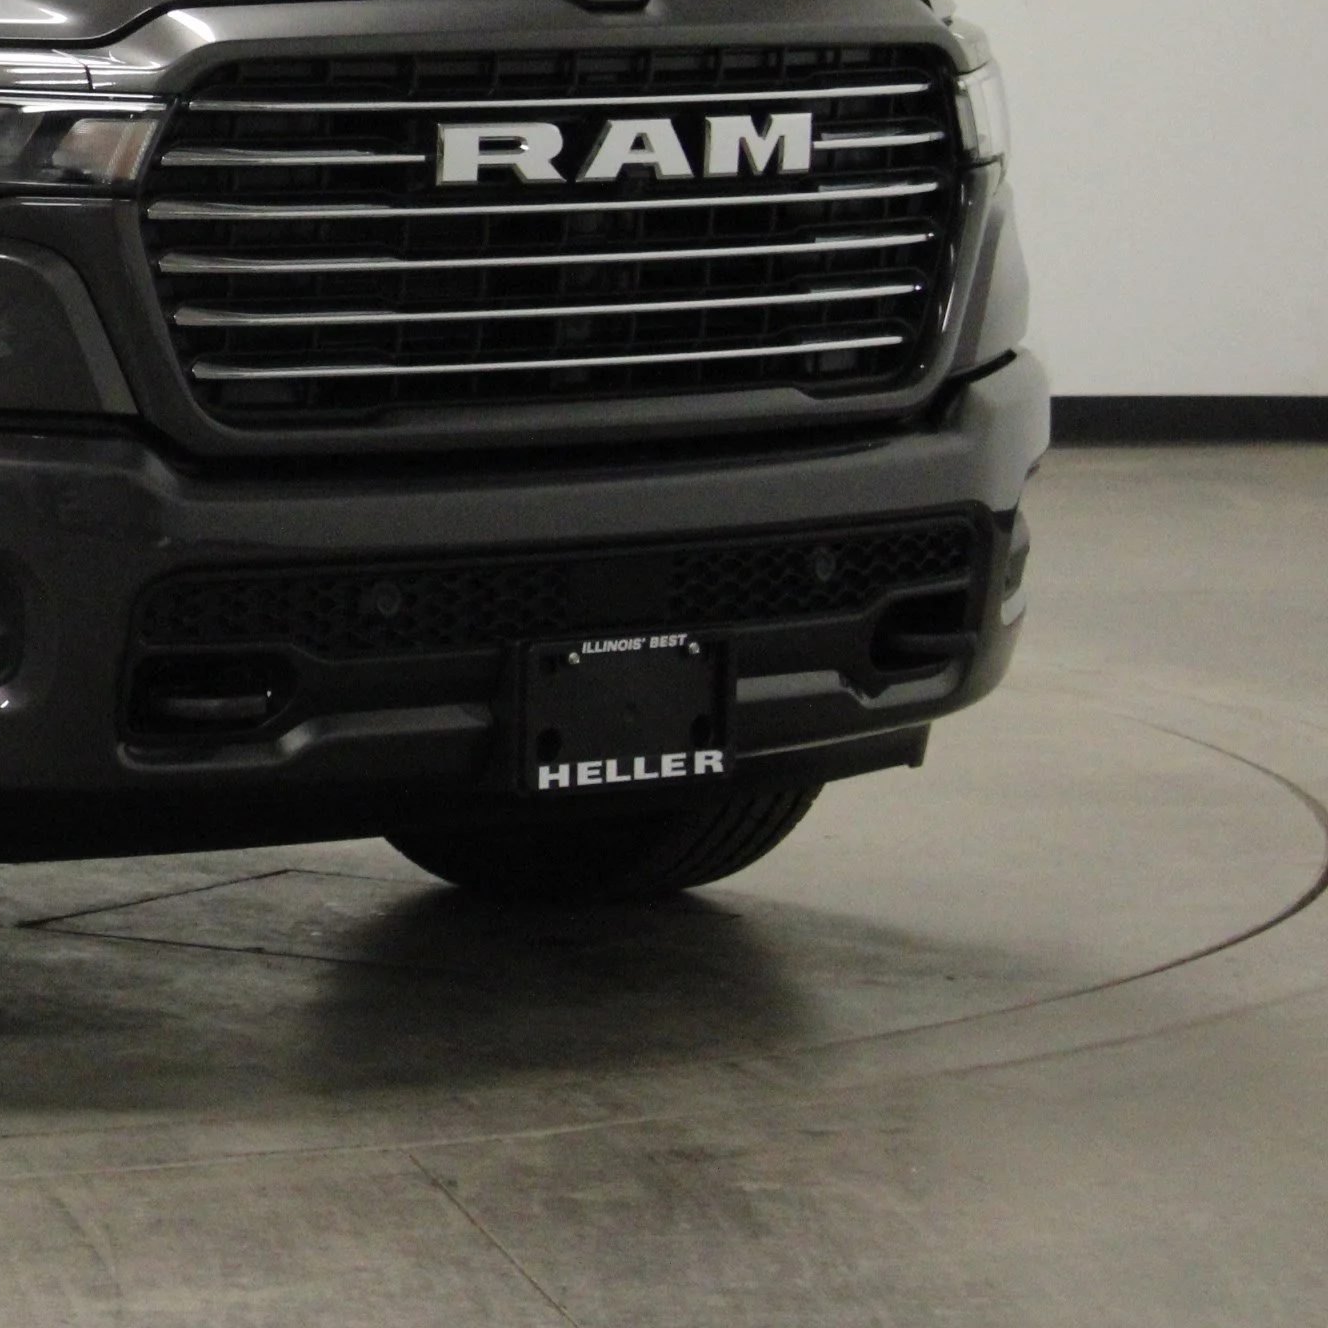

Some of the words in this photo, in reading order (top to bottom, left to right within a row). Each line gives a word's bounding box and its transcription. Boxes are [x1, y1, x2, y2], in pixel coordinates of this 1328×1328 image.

[435, 112, 813, 186] RAM
[581, 637, 646, 654] ILLINOIS'
[649, 633, 688, 649] BEST
[538, 749, 724, 790] HELLER
